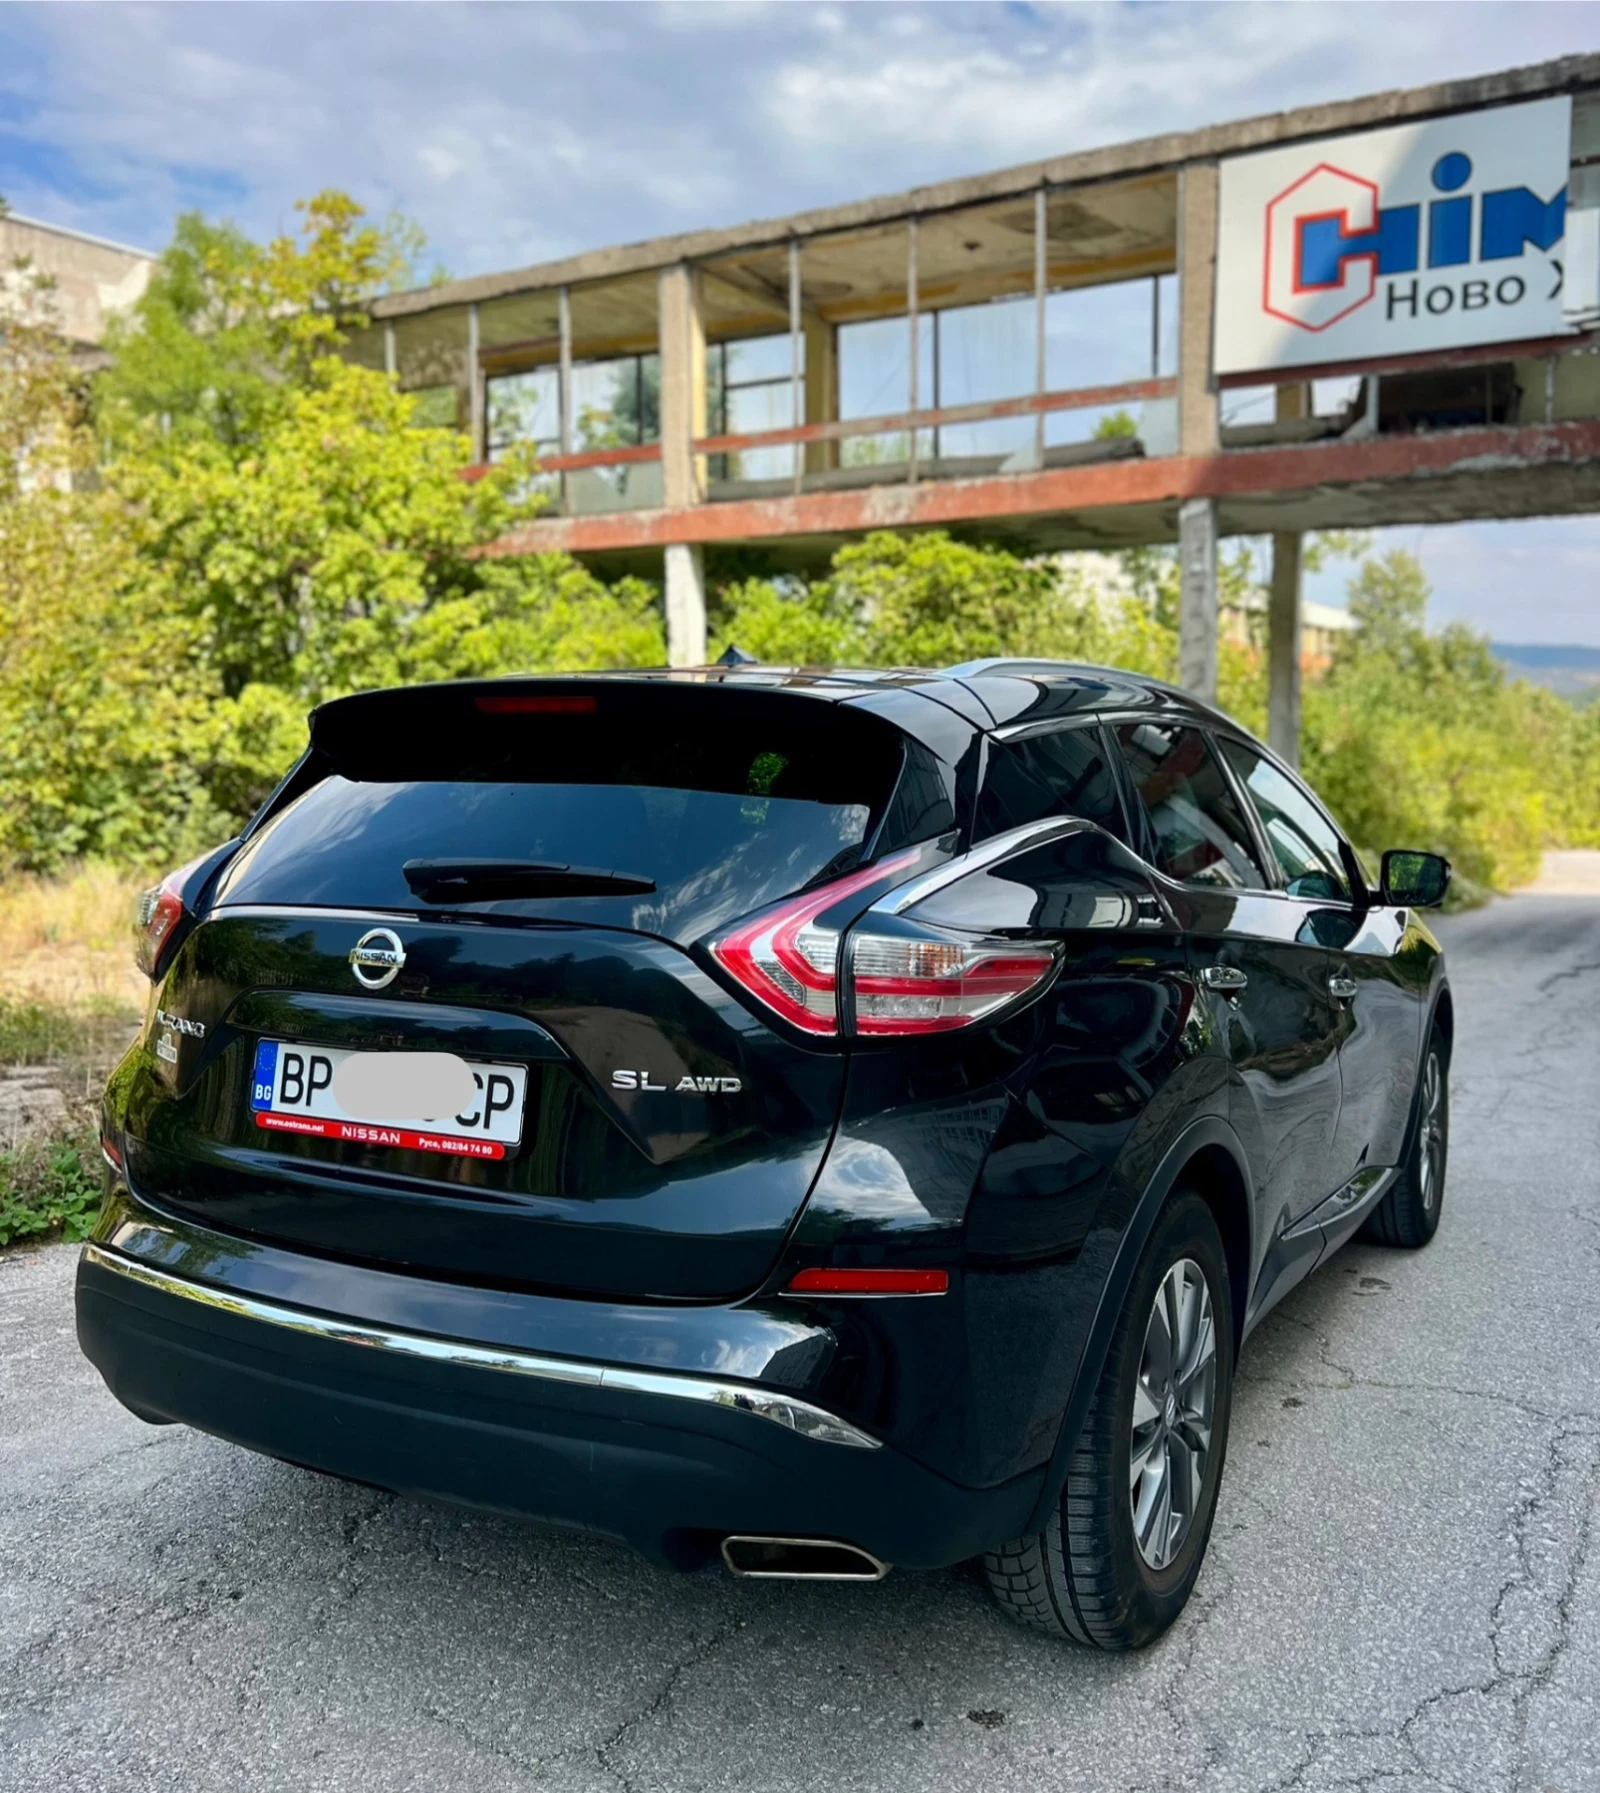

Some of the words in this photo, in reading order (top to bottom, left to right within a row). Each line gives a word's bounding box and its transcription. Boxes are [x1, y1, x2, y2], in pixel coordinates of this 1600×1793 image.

[350, 951, 398, 964] NISSAN
[157, 1009, 205, 1038] URANO
[279, 1052, 333, 1107] BP
[611, 1070, 667, 1091] SL
[675, 1076, 742, 1093] AWD
[255, 1083, 272, 1101] BG
[341, 1125, 401, 1144] NISSAN
[470, 1143, 480, 1154] 74
